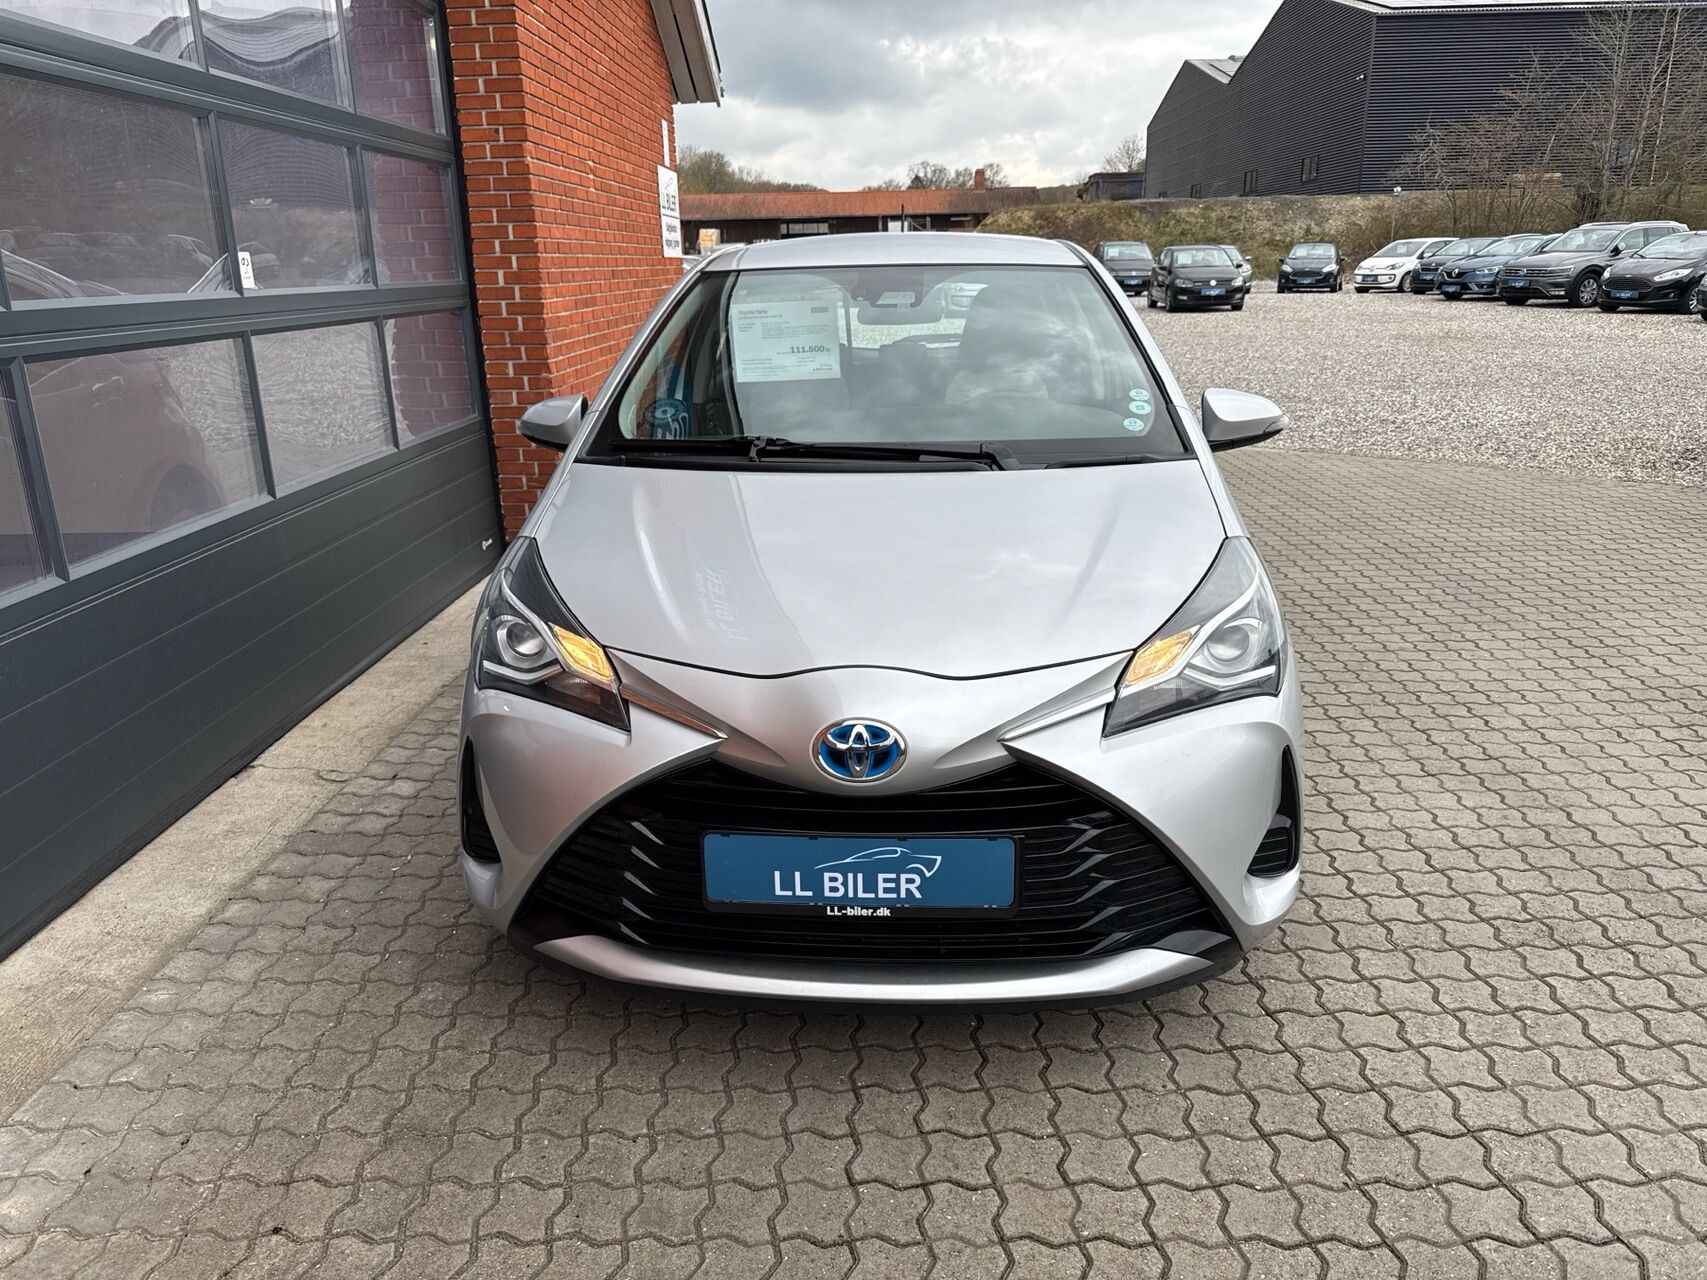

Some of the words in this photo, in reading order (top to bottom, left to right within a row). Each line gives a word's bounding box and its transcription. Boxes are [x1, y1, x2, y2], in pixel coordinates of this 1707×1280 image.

[790, 345, 825, 354] 111.500
[773, 870, 814, 897] LL
[823, 871, 923, 899] BILER
[826, 906, 891, 917] LL-biler.dk
